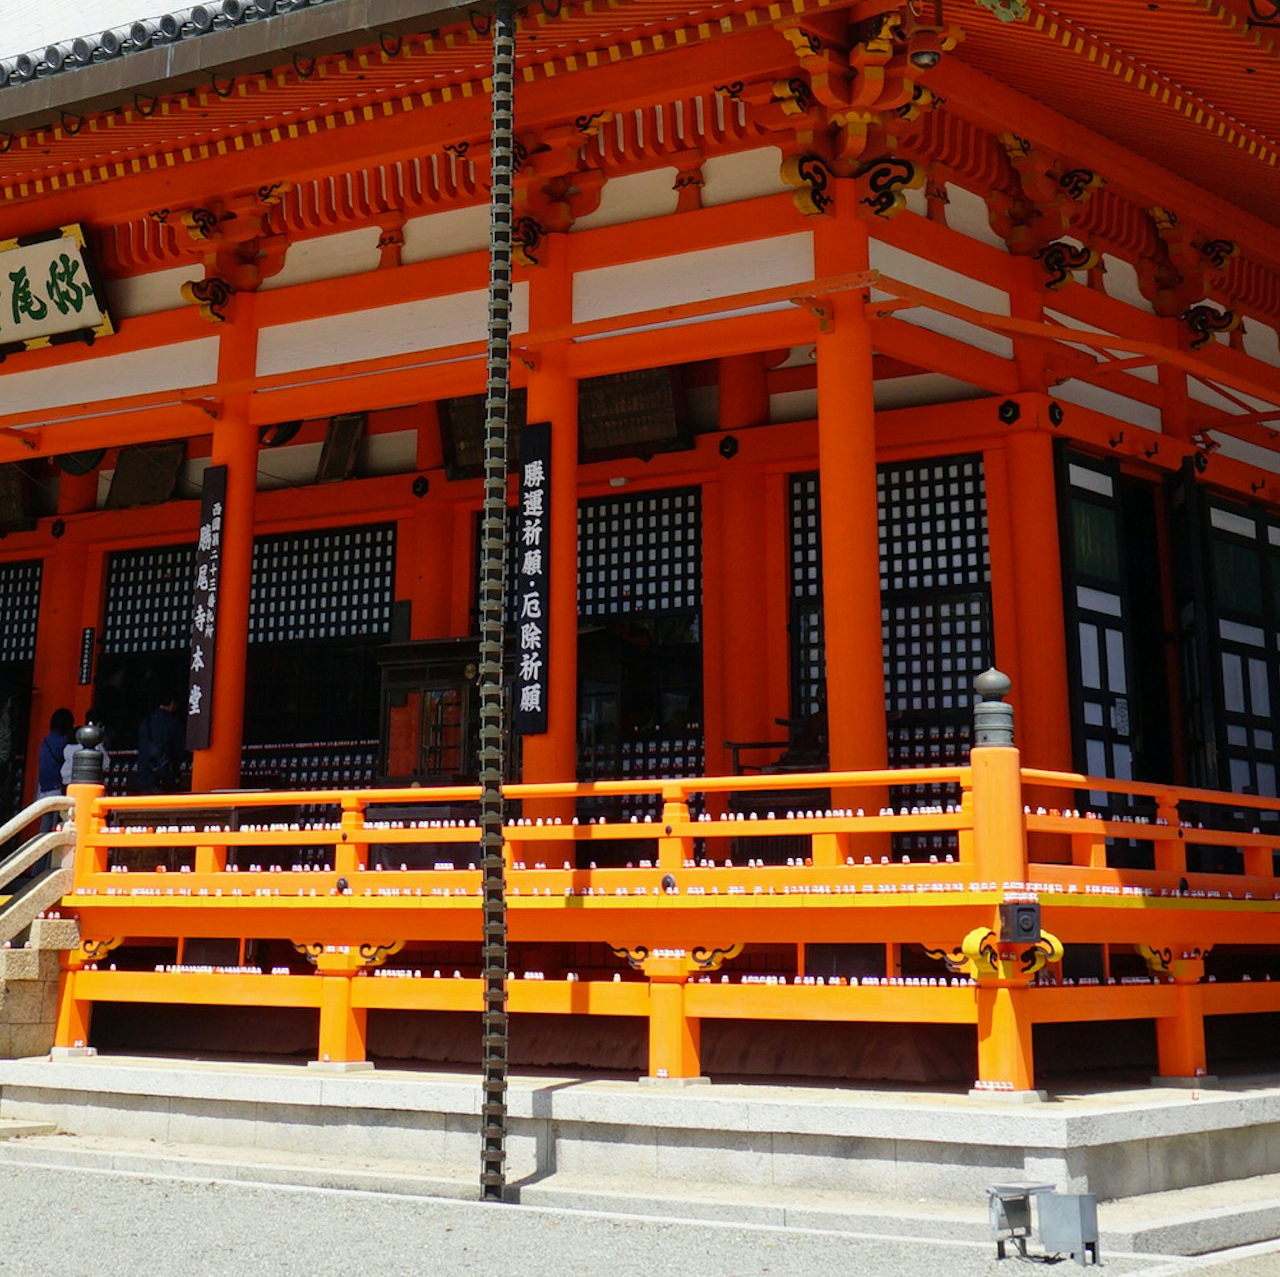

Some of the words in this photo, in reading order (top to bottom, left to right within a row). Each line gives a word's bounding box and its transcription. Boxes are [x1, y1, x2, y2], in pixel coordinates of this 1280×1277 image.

[188, 523, 212, 715] 勝尾寺本堂
